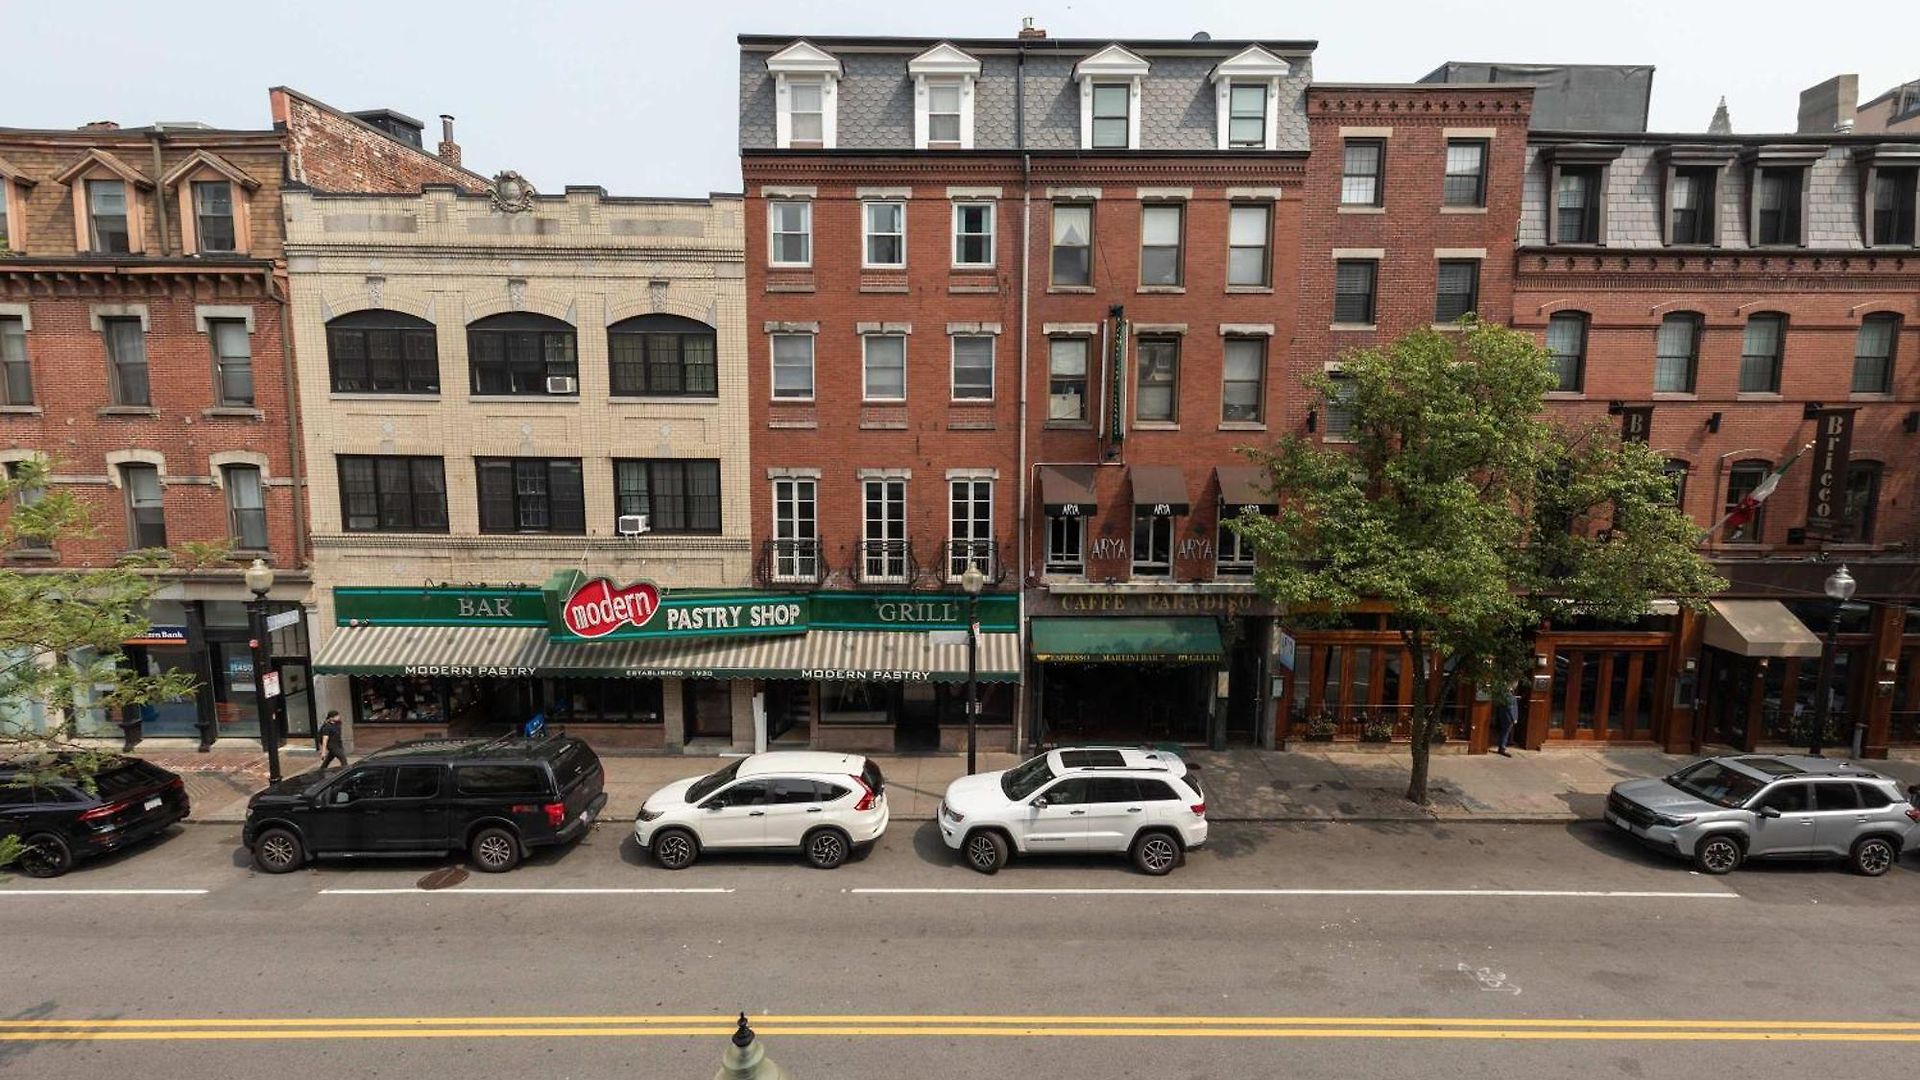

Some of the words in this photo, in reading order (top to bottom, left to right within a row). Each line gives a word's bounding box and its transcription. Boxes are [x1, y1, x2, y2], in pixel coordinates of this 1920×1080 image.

[1817, 416, 1843, 517] Bricco
[1062, 504, 1080, 515] ARYA
[1154, 504, 1171, 515] ARYA
[1091, 538, 1127, 560] ARYA
[1177, 538, 1213, 560] ARYA
[458, 598, 513, 617] BAR
[572, 580, 650, 630] modern
[1148, 594, 1252, 611] PARADISO
[667, 606, 742, 631] PASTRY
[750, 604, 801, 627] SHOP
[878, 603, 957, 622] GRILL
[161, 630, 184, 638] Bank
[405, 665, 472, 676] MODERN
[478, 666, 537, 677] PASTRY
[626, 669, 684, 677] ESTABLISHED
[801, 669, 867, 679] MODERN
[873, 670, 930, 680] PASTRY
